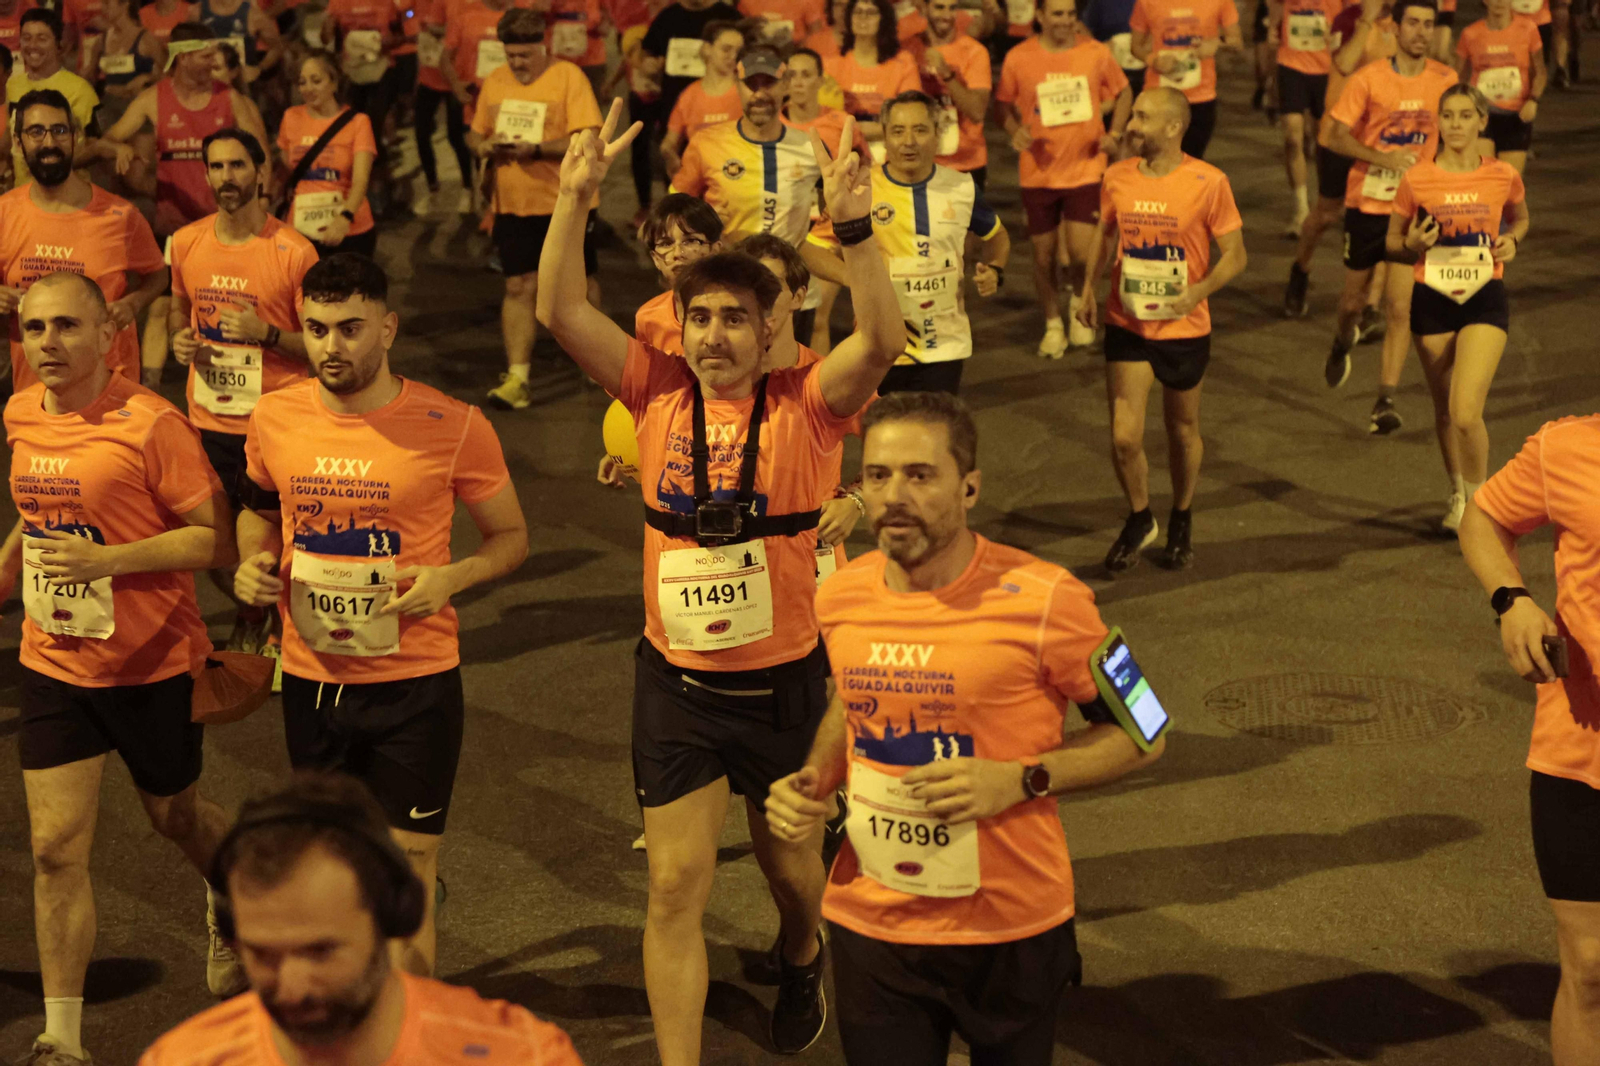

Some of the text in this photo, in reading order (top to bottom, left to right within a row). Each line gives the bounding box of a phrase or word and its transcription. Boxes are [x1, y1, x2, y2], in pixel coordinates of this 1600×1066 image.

[1445, 193, 1478, 204] XXXV
[1134, 200, 1167, 214] XXXV
[35, 244, 74, 259] XXXV
[1439, 268, 1479, 280] 10401
[210, 275, 248, 291] XXXV
[904, 277, 947, 292] 14461
[1139, 281, 1166, 295] 945
[205, 370, 246, 387] 11530
[29, 456, 70, 474] XXXV
[313, 457, 373, 478] XXXV
[15, 475, 80, 486] CARRERA NOCTURNA
[290, 476, 390, 488] CARRERA NOCTURNA
[18, 484, 81, 497] GUADALQUIVIR
[296, 485, 390, 500] GUADALQUIVIR
[680, 580, 748, 607] 11491
[308, 591, 375, 616] 10617
[867, 643, 935, 667] XXXV
[843, 667, 955, 680] CARRERA NOCTURNA
[848, 679, 955, 695] GUADALQUIVIR
[868, 815, 950, 847] 17896
